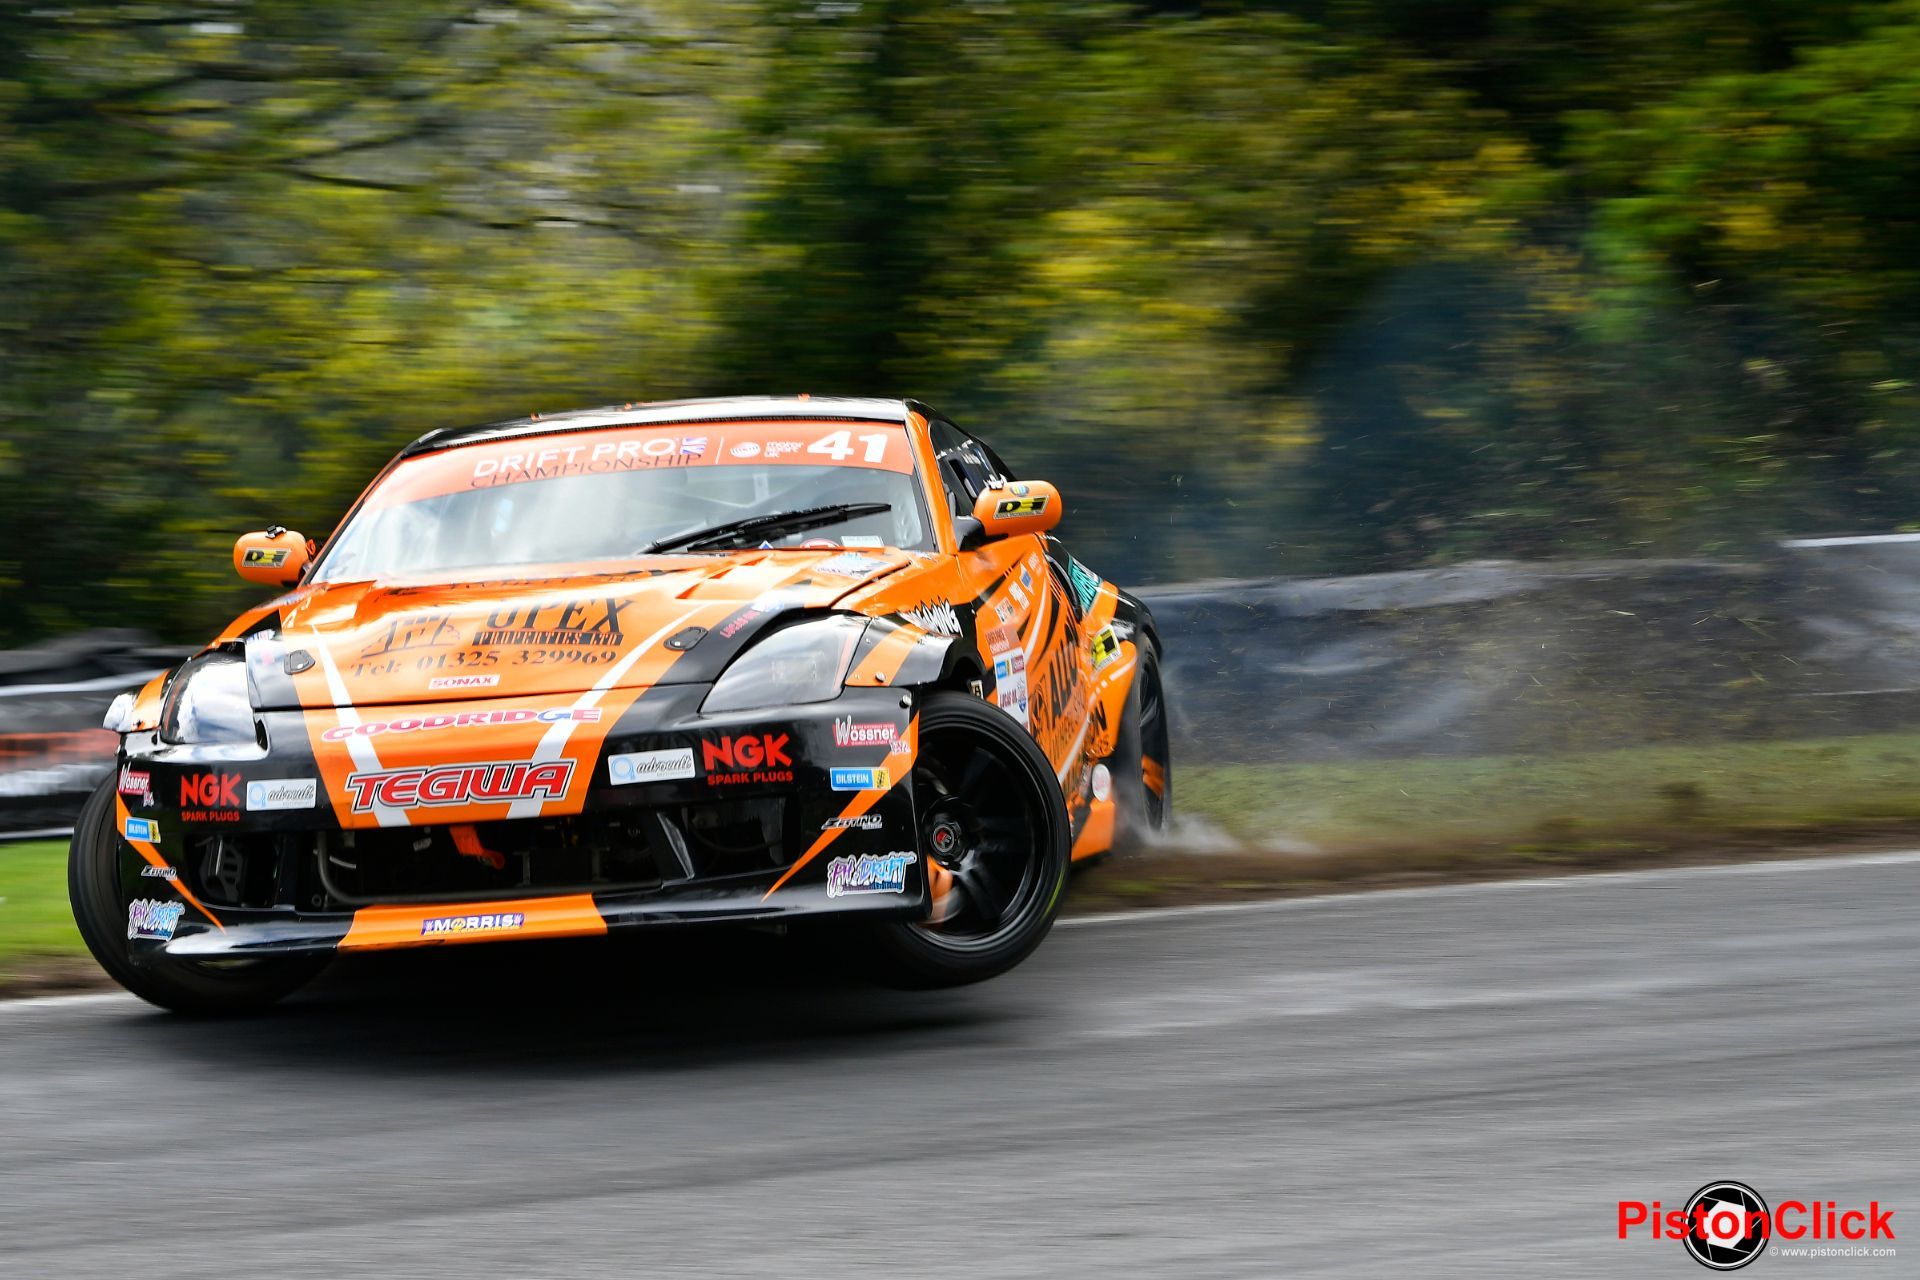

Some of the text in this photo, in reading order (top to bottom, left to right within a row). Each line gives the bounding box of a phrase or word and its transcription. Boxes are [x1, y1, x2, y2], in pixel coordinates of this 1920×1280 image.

[474, 437, 676, 478] DRIFT PRO
[807, 430, 888, 464] 41
[470, 453, 702, 489] CHAMPIONSHIP
[478, 632, 621, 645] PROPERTIES LTD
[416, 650, 500, 670] 01325
[512, 650, 617, 665] 329969
[432, 677, 494, 688] SONAX
[322, 708, 602, 741] GOODRIDGE
[702, 732, 792, 771] NGK
[181, 773, 241, 807] NGK
[350, 762, 572, 810] TEGIWA
[707, 771, 793, 785] SPARK PLUGS
[835, 773, 869, 784] BILSTEIN
[181, 810, 240, 822] SPARK PLUGS
[433, 913, 515, 933] MORRIS
